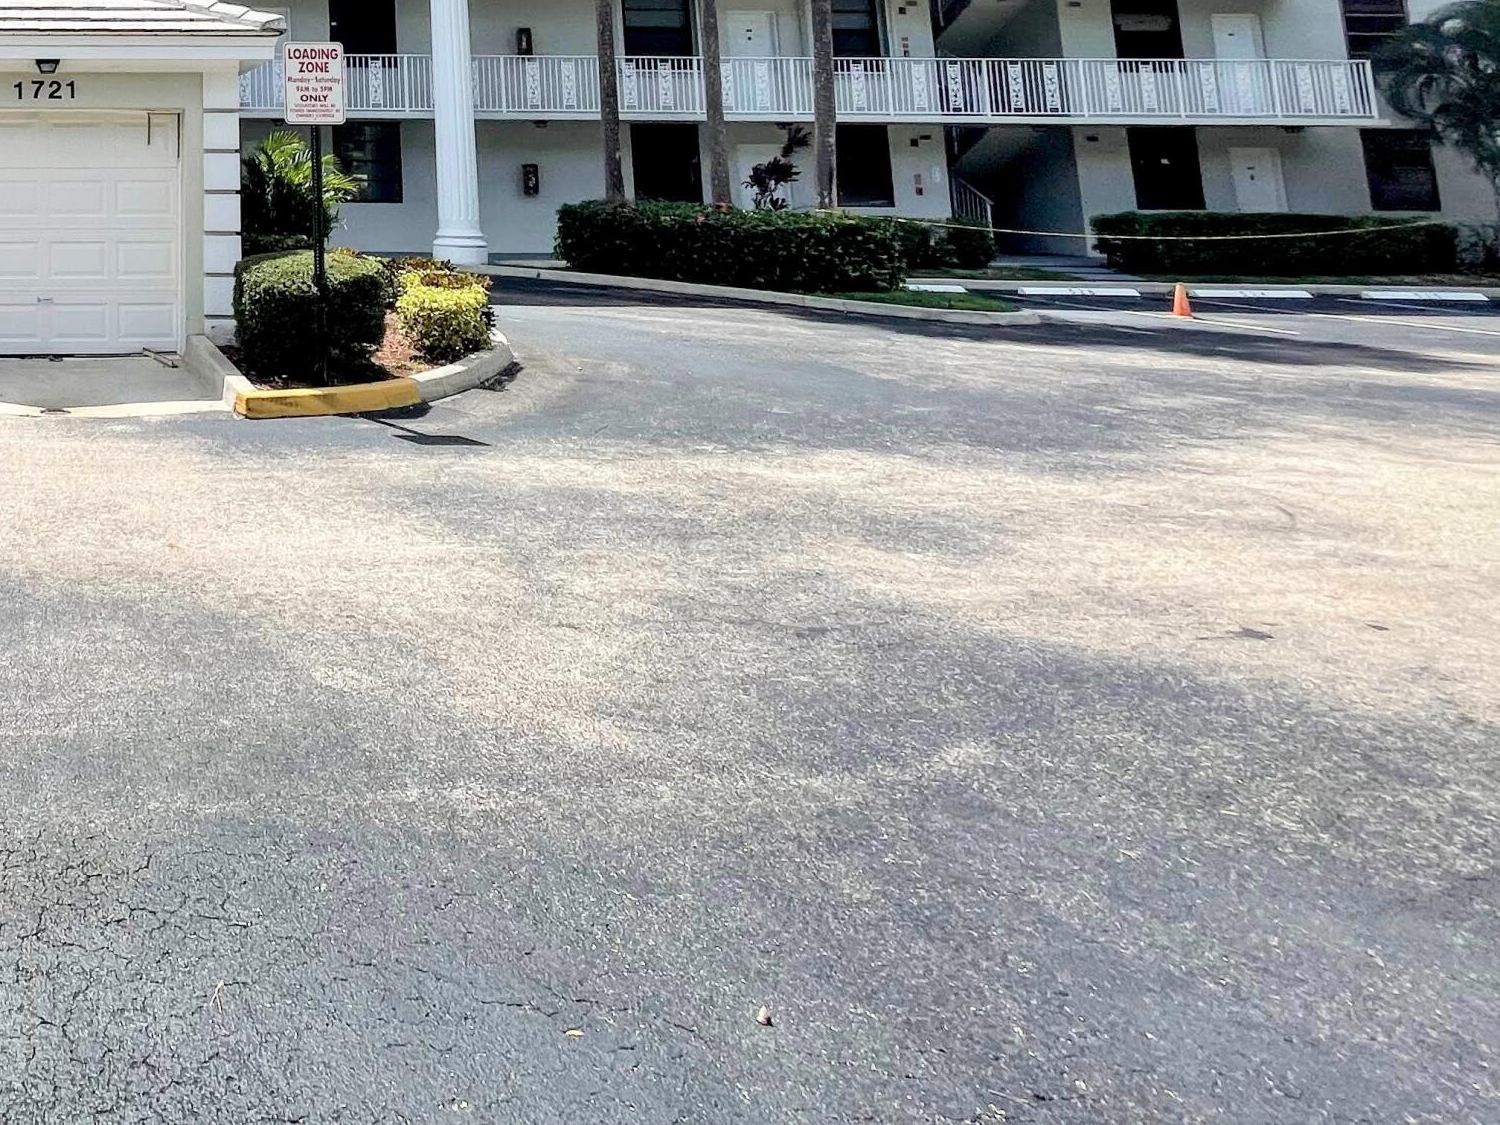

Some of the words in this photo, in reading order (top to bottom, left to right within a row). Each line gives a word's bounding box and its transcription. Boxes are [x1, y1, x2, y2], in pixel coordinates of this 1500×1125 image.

[288, 48, 338, 59] LOADING
[298, 61, 330, 73] ZONE
[13, 80, 75, 100] 1721
[300, 94, 329, 102] ONLY
